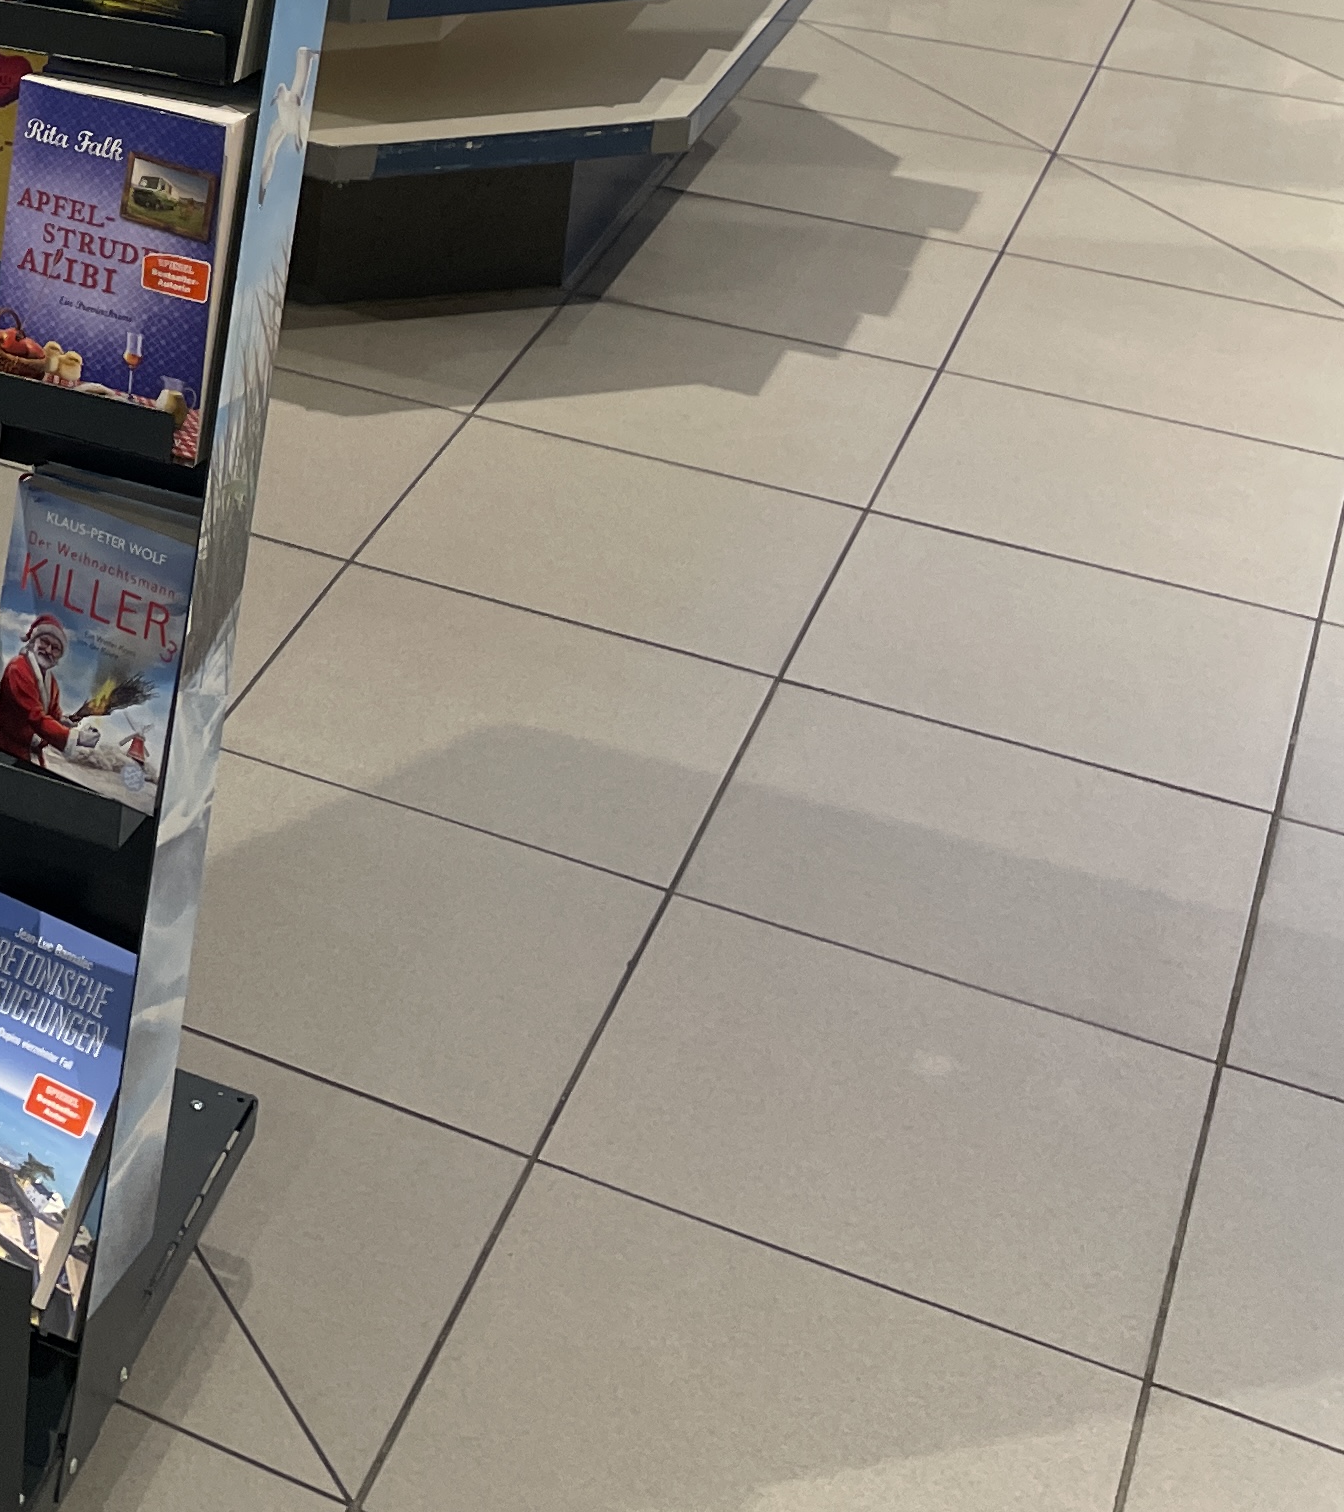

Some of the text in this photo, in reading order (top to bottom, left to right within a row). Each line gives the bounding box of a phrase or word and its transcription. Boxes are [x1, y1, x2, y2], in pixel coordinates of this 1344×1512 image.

[24, 117, 124, 162] Rita Falk
[17, 187, 116, 229] APFEL-
[17, 247, 117, 296] ALIBI
[46, 511, 167, 566] KLAUS-PETER WOLF
[27, 530, 176, 599] Der Weihnachtsmann
[20, 551, 170, 647] KILLER
[160, 640, 177, 663] 3
